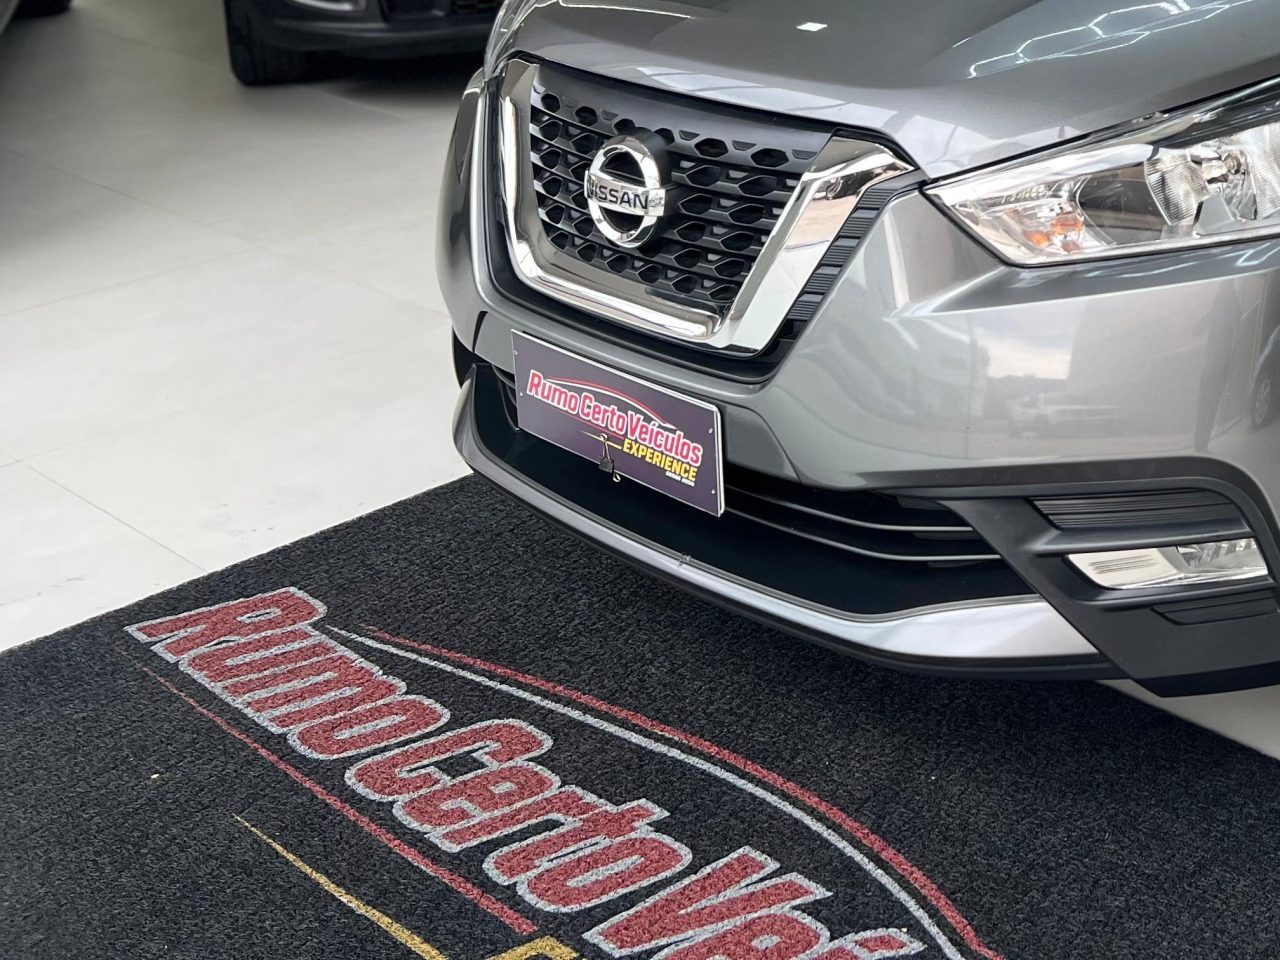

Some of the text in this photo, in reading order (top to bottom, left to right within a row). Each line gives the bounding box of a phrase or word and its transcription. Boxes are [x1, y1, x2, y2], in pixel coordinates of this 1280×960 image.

[588, 172, 649, 210] NISSAN
[527, 369, 703, 466] Rumo Certo Veículos
[623, 439, 697, 481] EXPERIENCE
[125, 586, 450, 761] Rumo
[344, 718, 693, 913] Certo
